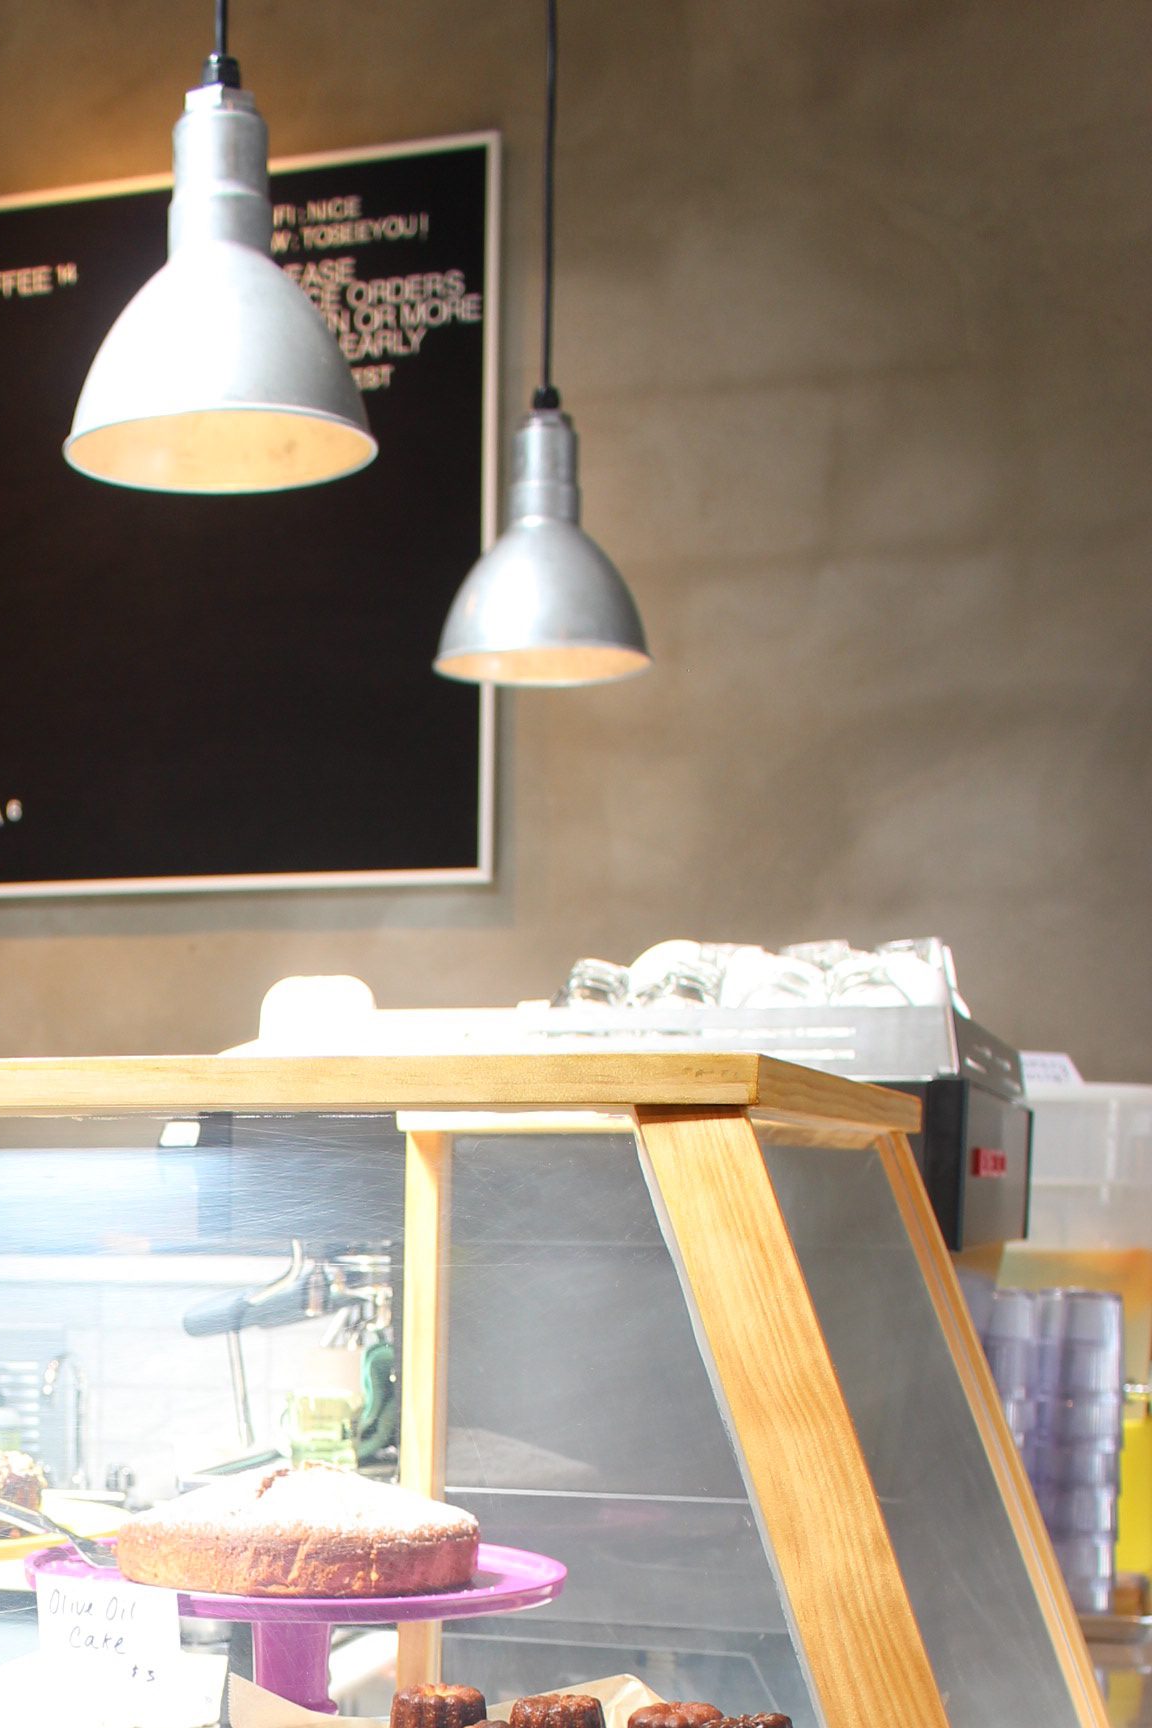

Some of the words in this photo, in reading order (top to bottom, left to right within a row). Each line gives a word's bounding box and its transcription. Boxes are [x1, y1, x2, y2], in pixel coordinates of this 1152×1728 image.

[347, 269, 466, 308] ORDERS
[354, 301, 397, 332] OR
[400, 293, 482, 326] MORE
[6, 799, 23, 822] 6
[49, 1588, 92, 1615] Olive
[105, 1596, 136, 1621] Oil
[69, 1626, 126, 1655] Cake
